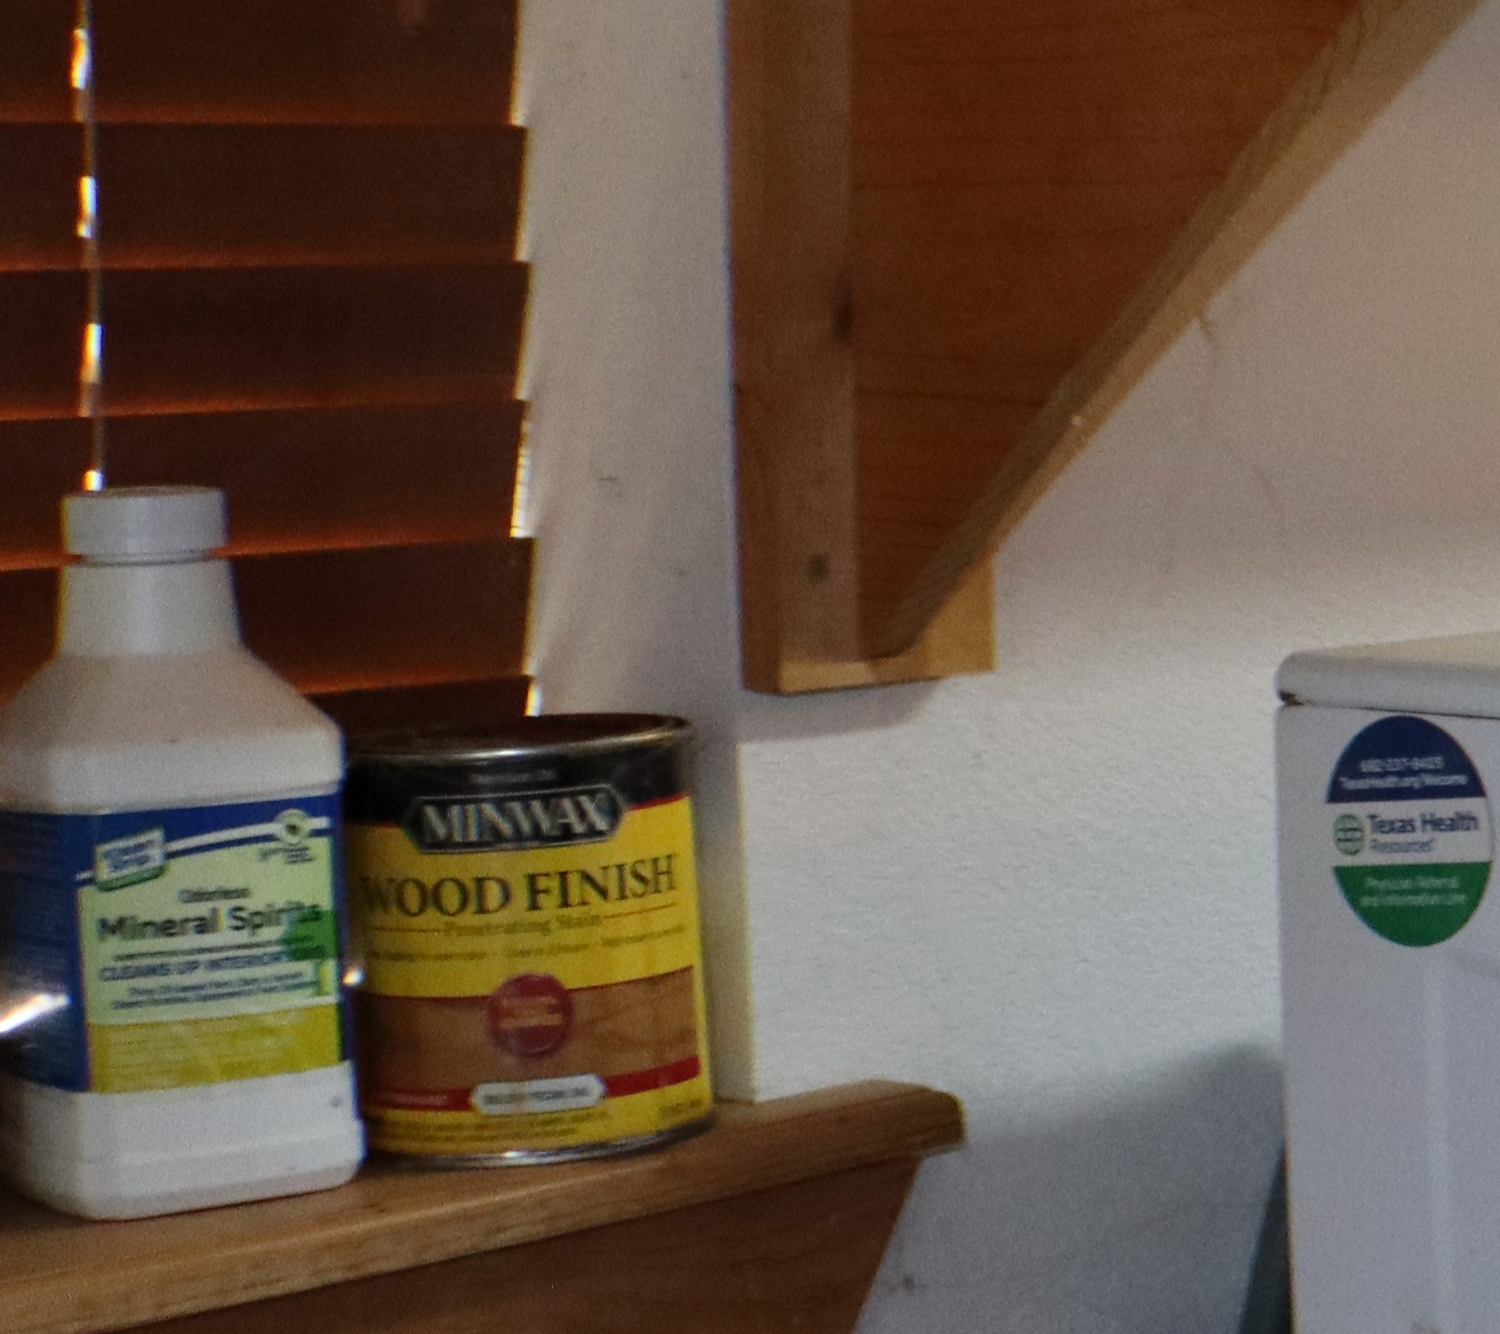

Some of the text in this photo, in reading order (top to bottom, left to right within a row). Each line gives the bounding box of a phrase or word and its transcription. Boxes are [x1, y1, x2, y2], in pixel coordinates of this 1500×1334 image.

[419, 793, 612, 844] MINWAX
[361, 853, 679, 917] WOOD FINISH
[97, 906, 221, 942] Mineral
